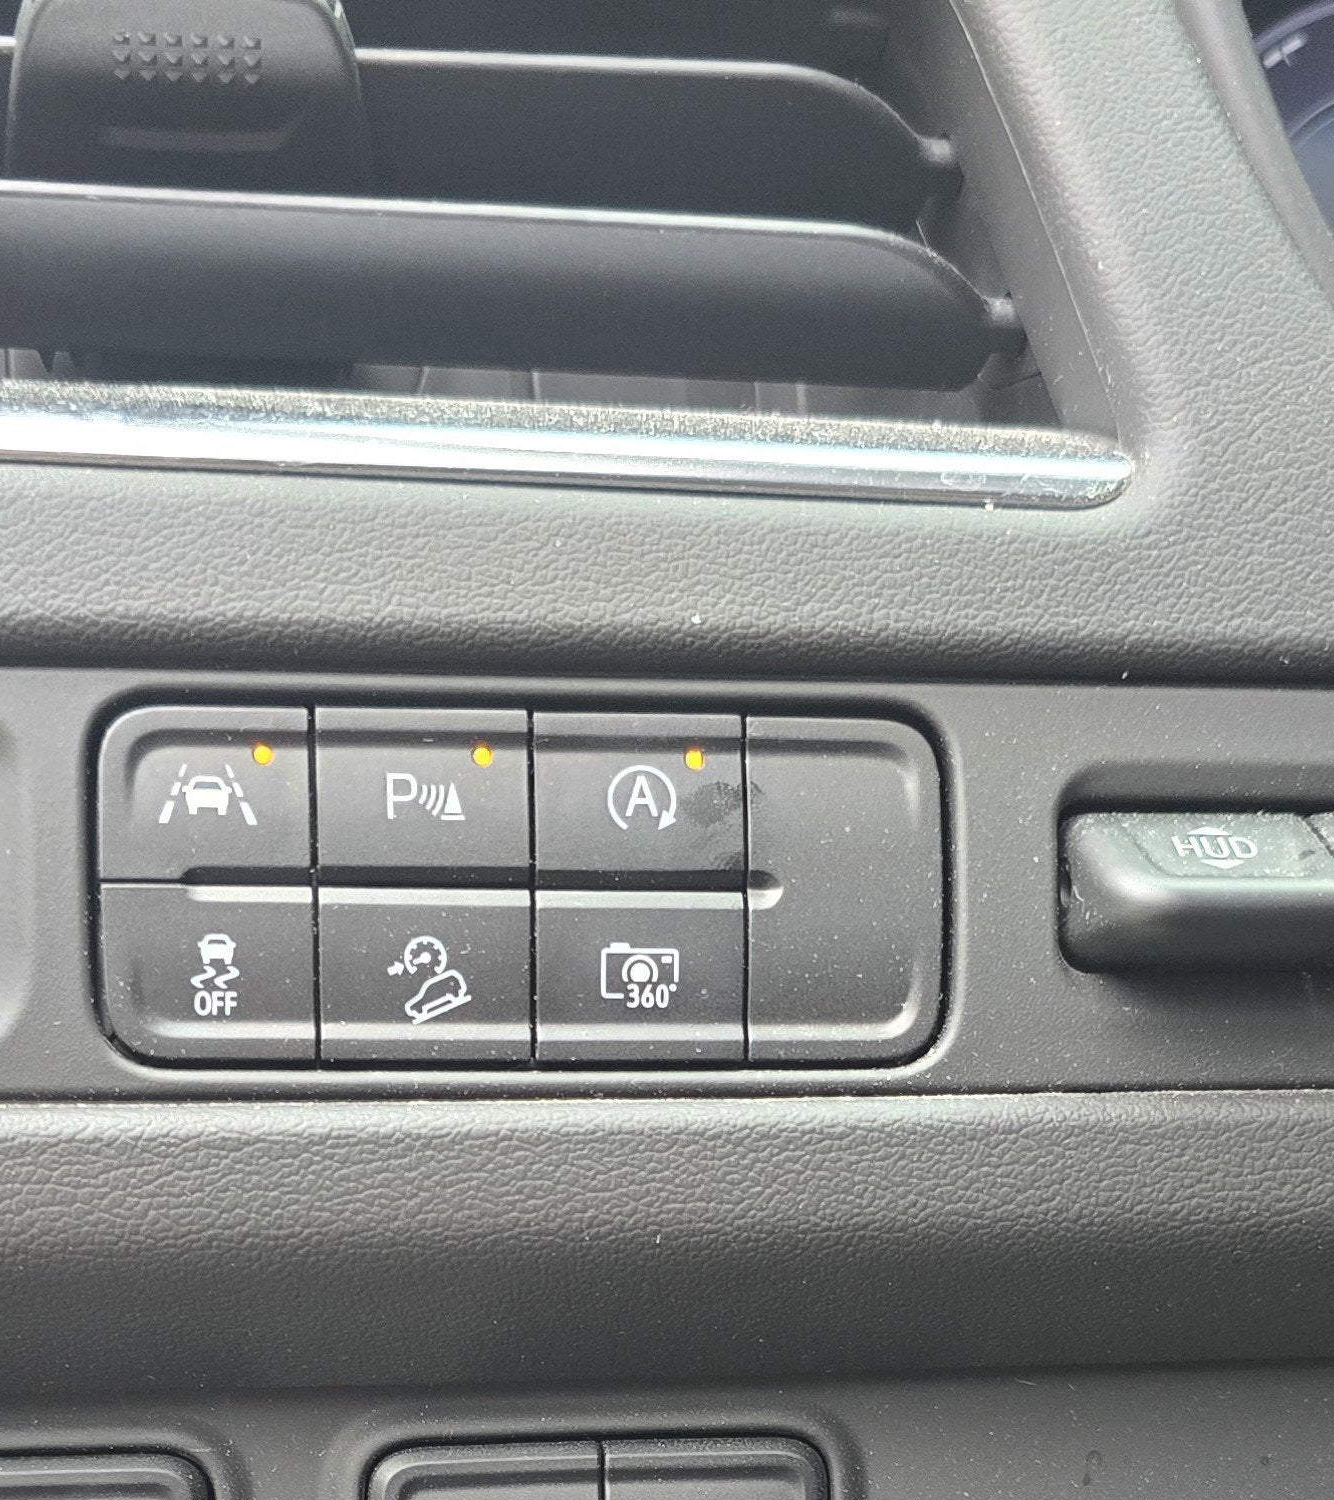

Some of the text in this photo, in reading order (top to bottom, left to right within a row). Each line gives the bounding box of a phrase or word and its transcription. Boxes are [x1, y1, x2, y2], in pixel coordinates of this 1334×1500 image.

[386, 773, 417, 819] P
[626, 776, 656, 818] A
[1170, 834, 1259, 860] HUD
[193, 990, 238, 1017] OFF
